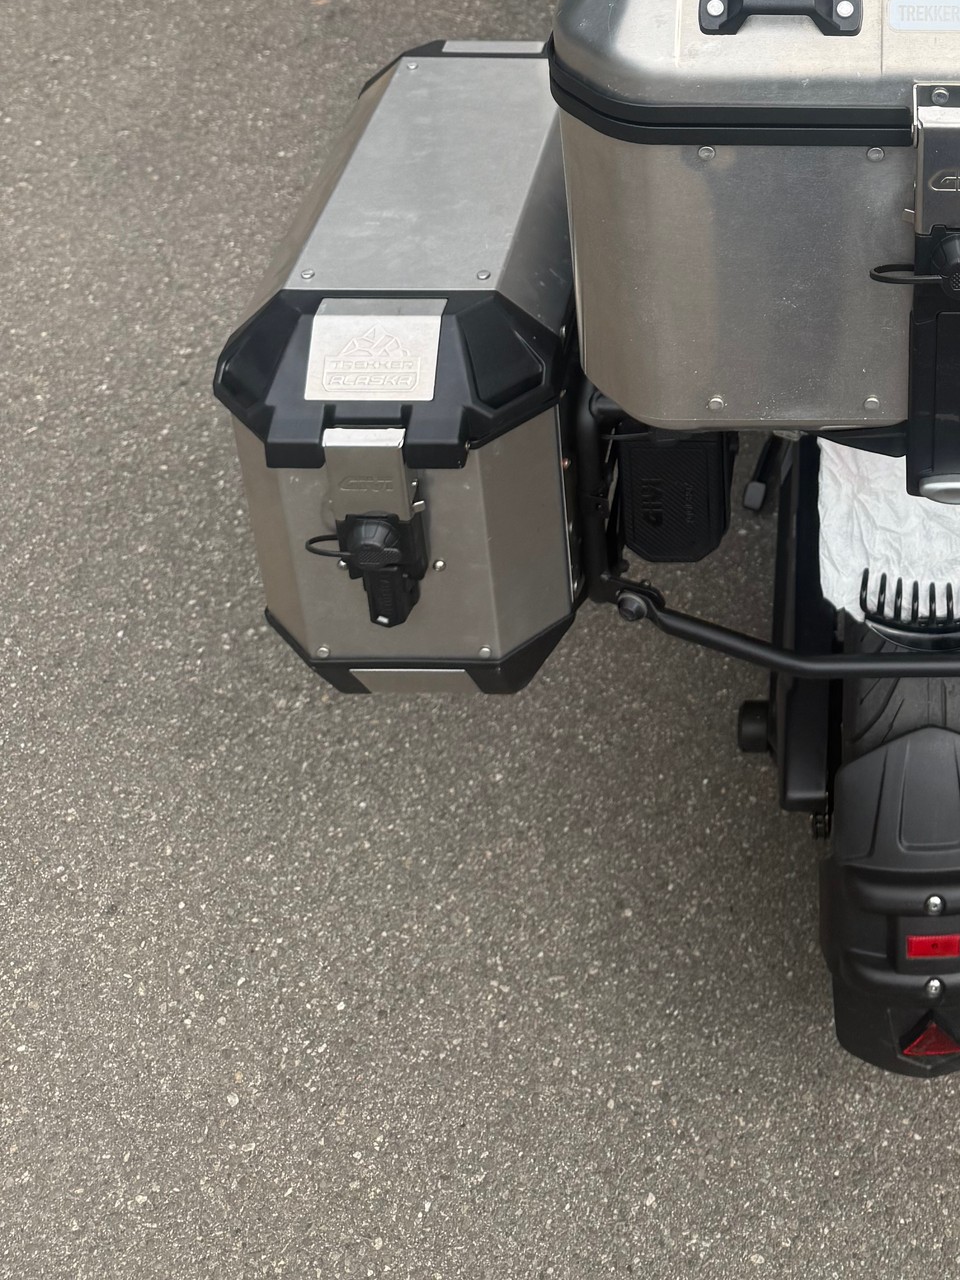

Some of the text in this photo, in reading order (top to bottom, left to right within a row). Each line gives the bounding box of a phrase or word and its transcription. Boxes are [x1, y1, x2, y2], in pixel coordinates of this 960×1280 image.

[897, 4, 960, 23] TREKKER
[329, 359, 415, 370] TREKKER
[327, 374, 414, 386] ALASKA
